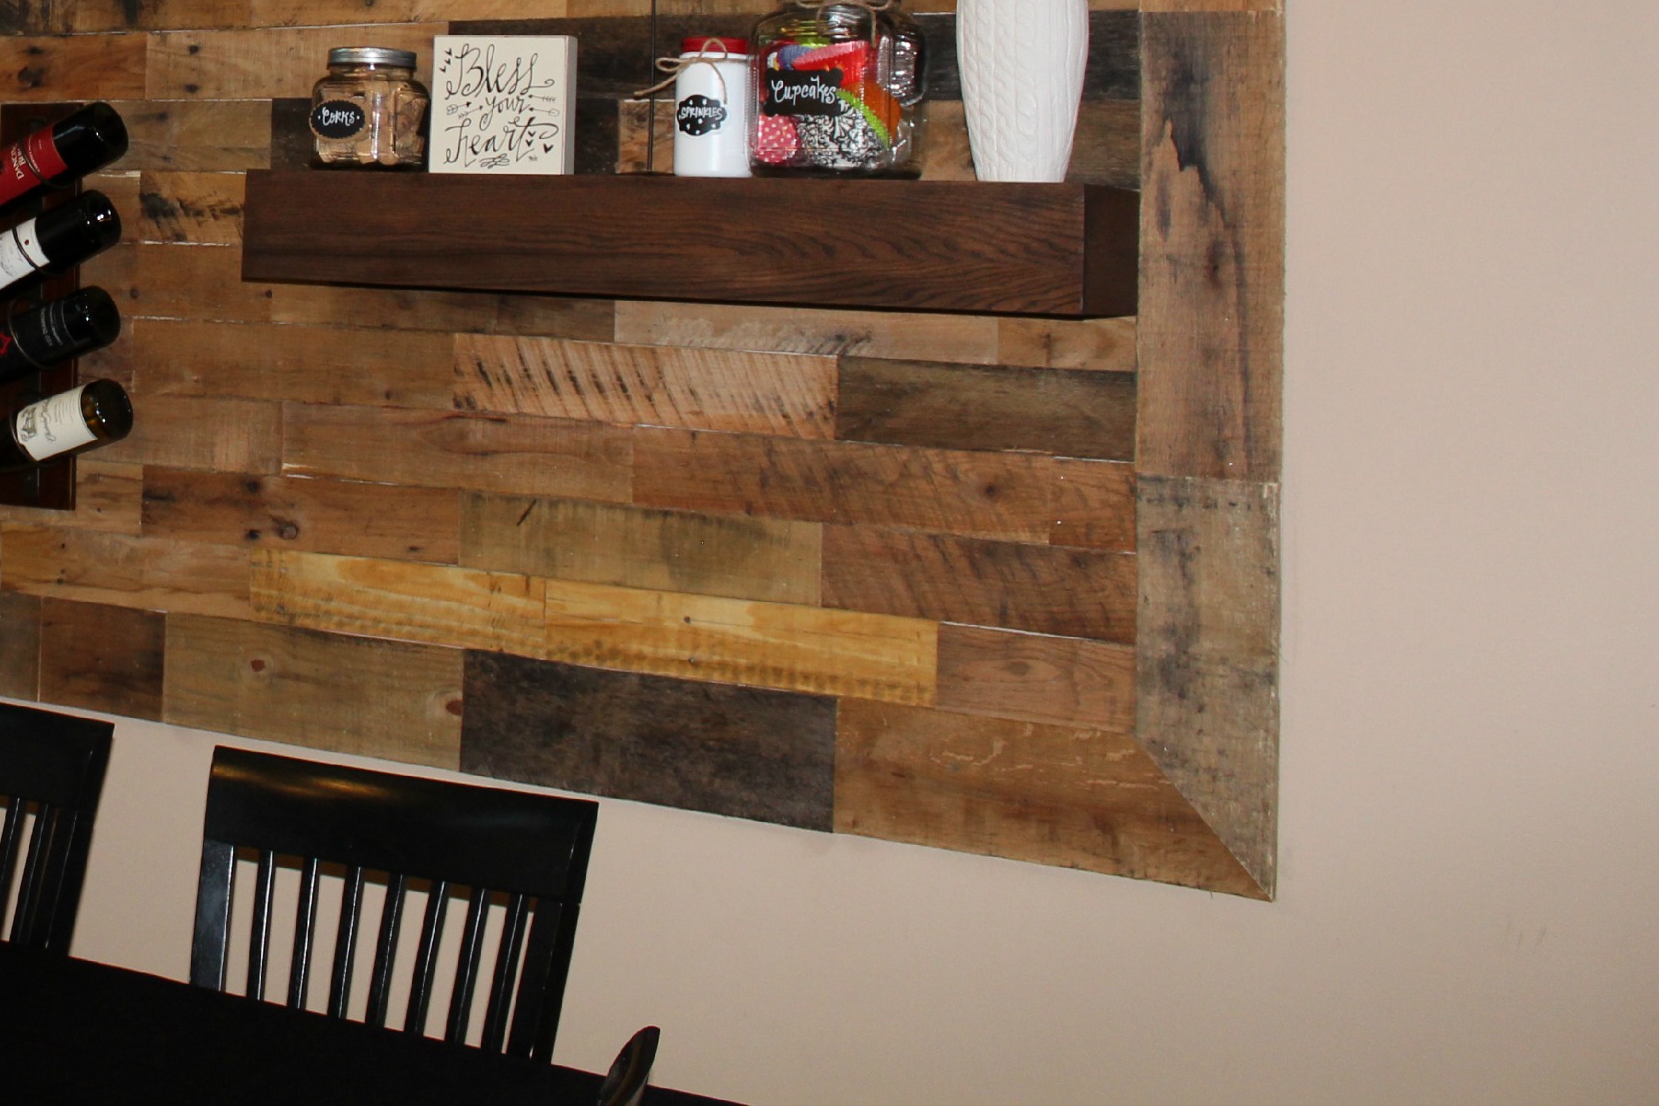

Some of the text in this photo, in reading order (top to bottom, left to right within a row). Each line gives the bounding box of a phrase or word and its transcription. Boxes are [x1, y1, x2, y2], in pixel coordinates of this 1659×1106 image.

[444, 43, 555, 100] Bless
[771, 75, 836, 106] Cupcakes
[479, 95, 531, 131] your
[679, 106, 722, 121] SPRINKLES
